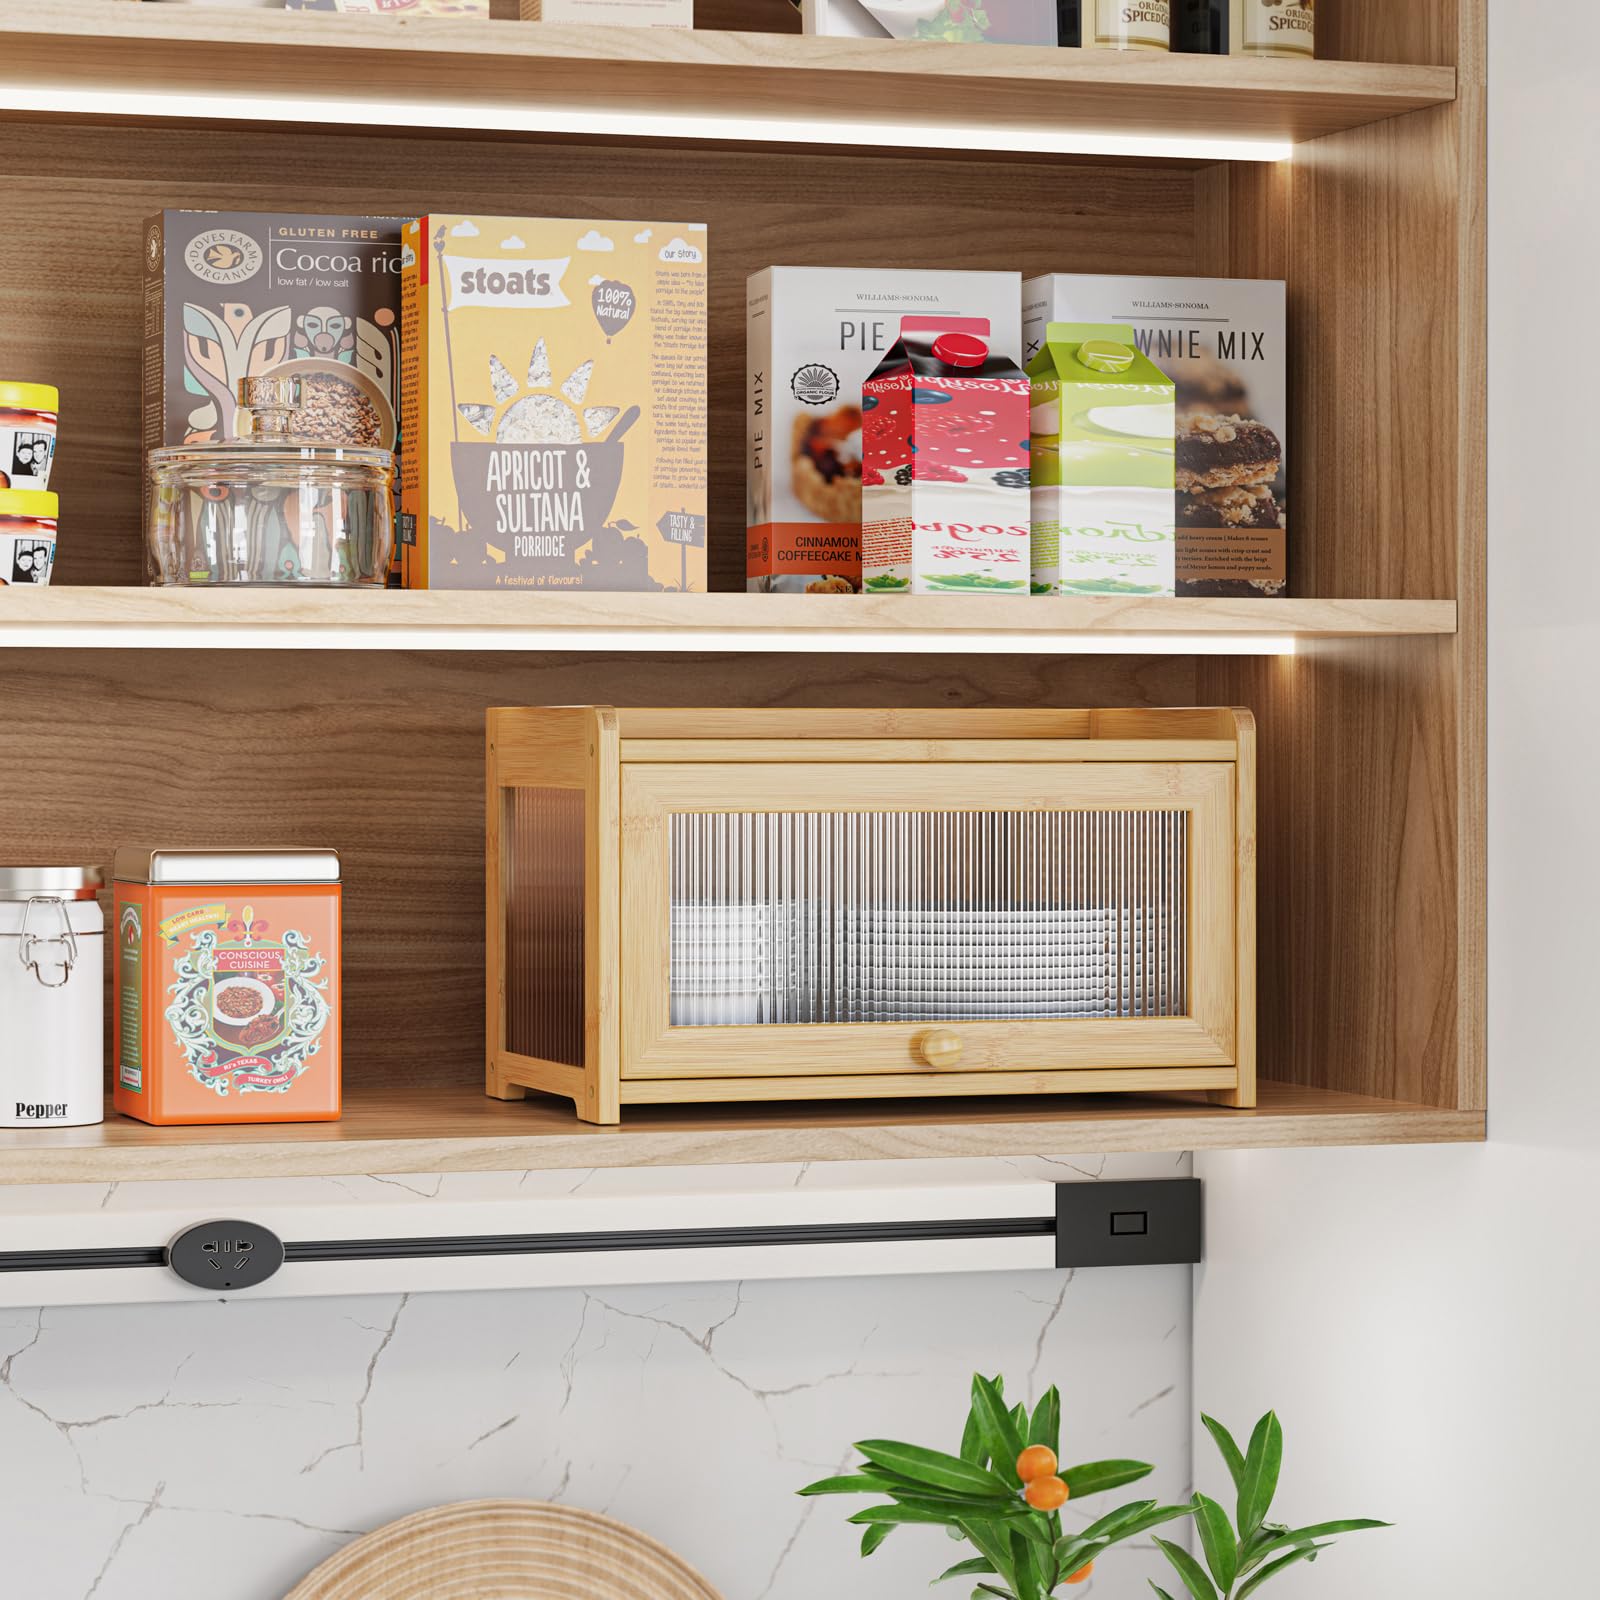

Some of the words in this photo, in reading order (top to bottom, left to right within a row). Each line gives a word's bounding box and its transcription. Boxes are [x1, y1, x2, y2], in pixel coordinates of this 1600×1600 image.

[1121, 8, 1161, 23] SPICED
[1269, 15, 1307, 31] SPICED
[279, 227, 336, 238] GLUTEN
[342, 228, 379, 239] FREE
[189, 232, 225, 260] DOVES
[229, 233, 258, 262] FARM
[679, 247, 697, 261] Story
[276, 247, 363, 273] Cocoa
[372, 248, 402, 274] ric
[192, 262, 256, 284] ORGANIC
[277, 277, 294, 287] low
[295, 277, 309, 287] fat
[315, 277, 332, 287] low
[333, 278, 350, 288] salt
[460, 266, 552, 297] stoats
[597, 287, 633, 307] 100%
[595, 304, 630, 320] Natural
[840, 321, 885, 351] PIE
[1134, 328, 1201, 359] WNIE
[1217, 330, 1266, 361] MIX
[754, 371, 763, 415] MIX
[754, 429, 763, 469] PIE
[486, 450, 567, 492] APRICOT
[575, 448, 591, 489] &
[495, 491, 585, 533] SULTANA
[669, 514, 688, 528] TASTY
[689, 517, 696, 530] &
[670, 527, 693, 543] FILLING
[795, 536, 859, 548] CINNAMON
[514, 535, 566, 558] PORRIDGE
[777, 550, 852, 562] COFFEECAKE
[495, 575, 502, 585] A
[504, 575, 536, 586] festival
[537, 575, 546, 586] of
[547, 575, 583, 586] flavours!
[171, 914, 186, 924] LOW
[186, 909, 204, 918] CARB
[218, 951, 281, 960] CONSCIOUS
[229, 960, 270, 969] CUISINE
[236, 1058, 258, 1066] TEXAS
[247, 1076, 272, 1085] TURKEY
[272, 1075, 289, 1084] CHILI
[15, 1102, 68, 1119] Pepper
